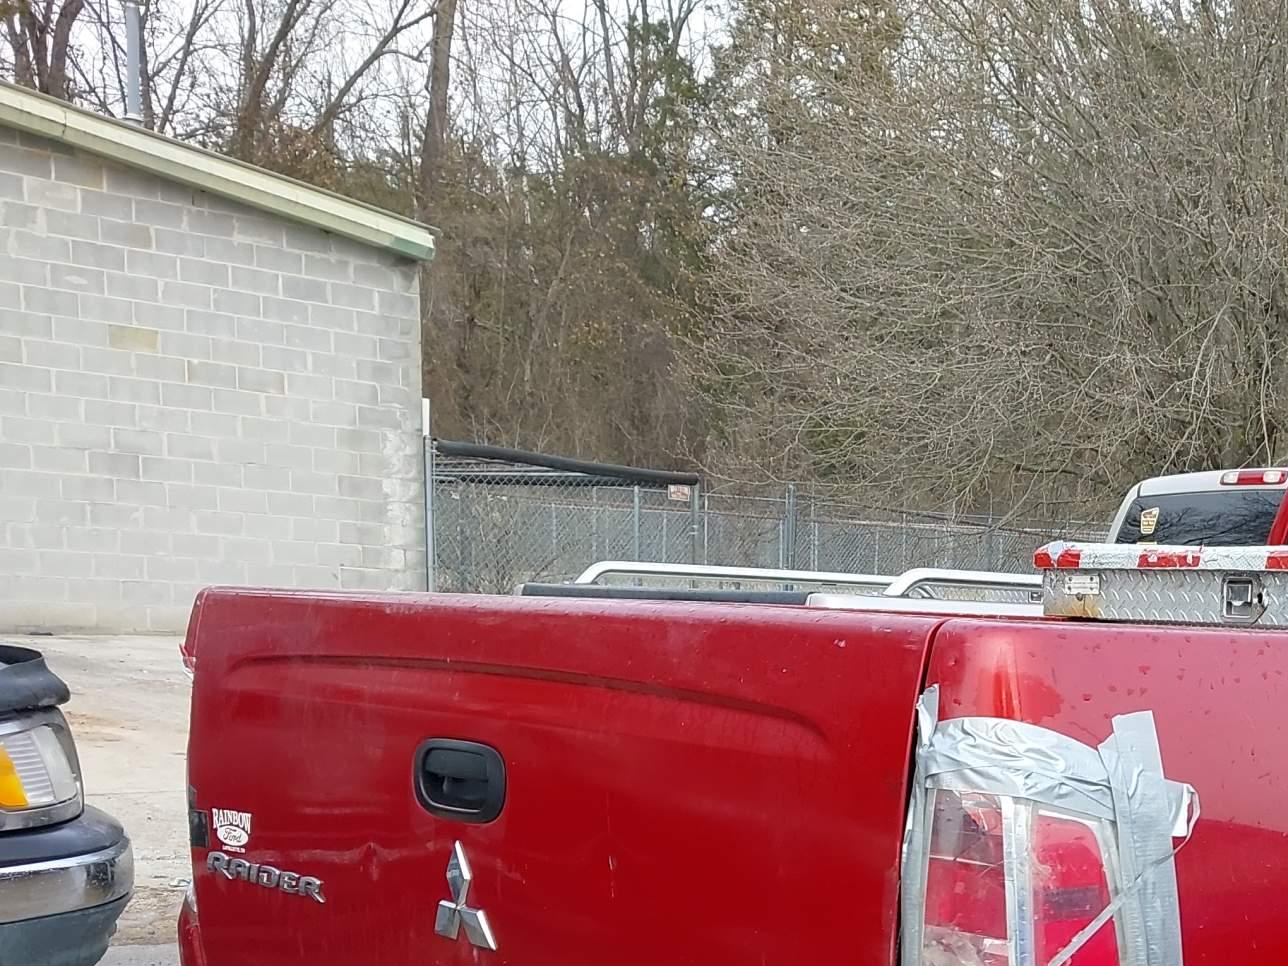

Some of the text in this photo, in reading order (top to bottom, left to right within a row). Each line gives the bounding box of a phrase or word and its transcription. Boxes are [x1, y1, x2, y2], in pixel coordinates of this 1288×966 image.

[212, 808, 252, 834] RAINBOW
[223, 828, 242, 843] Ford
[207, 851, 326, 903] RAIDER
